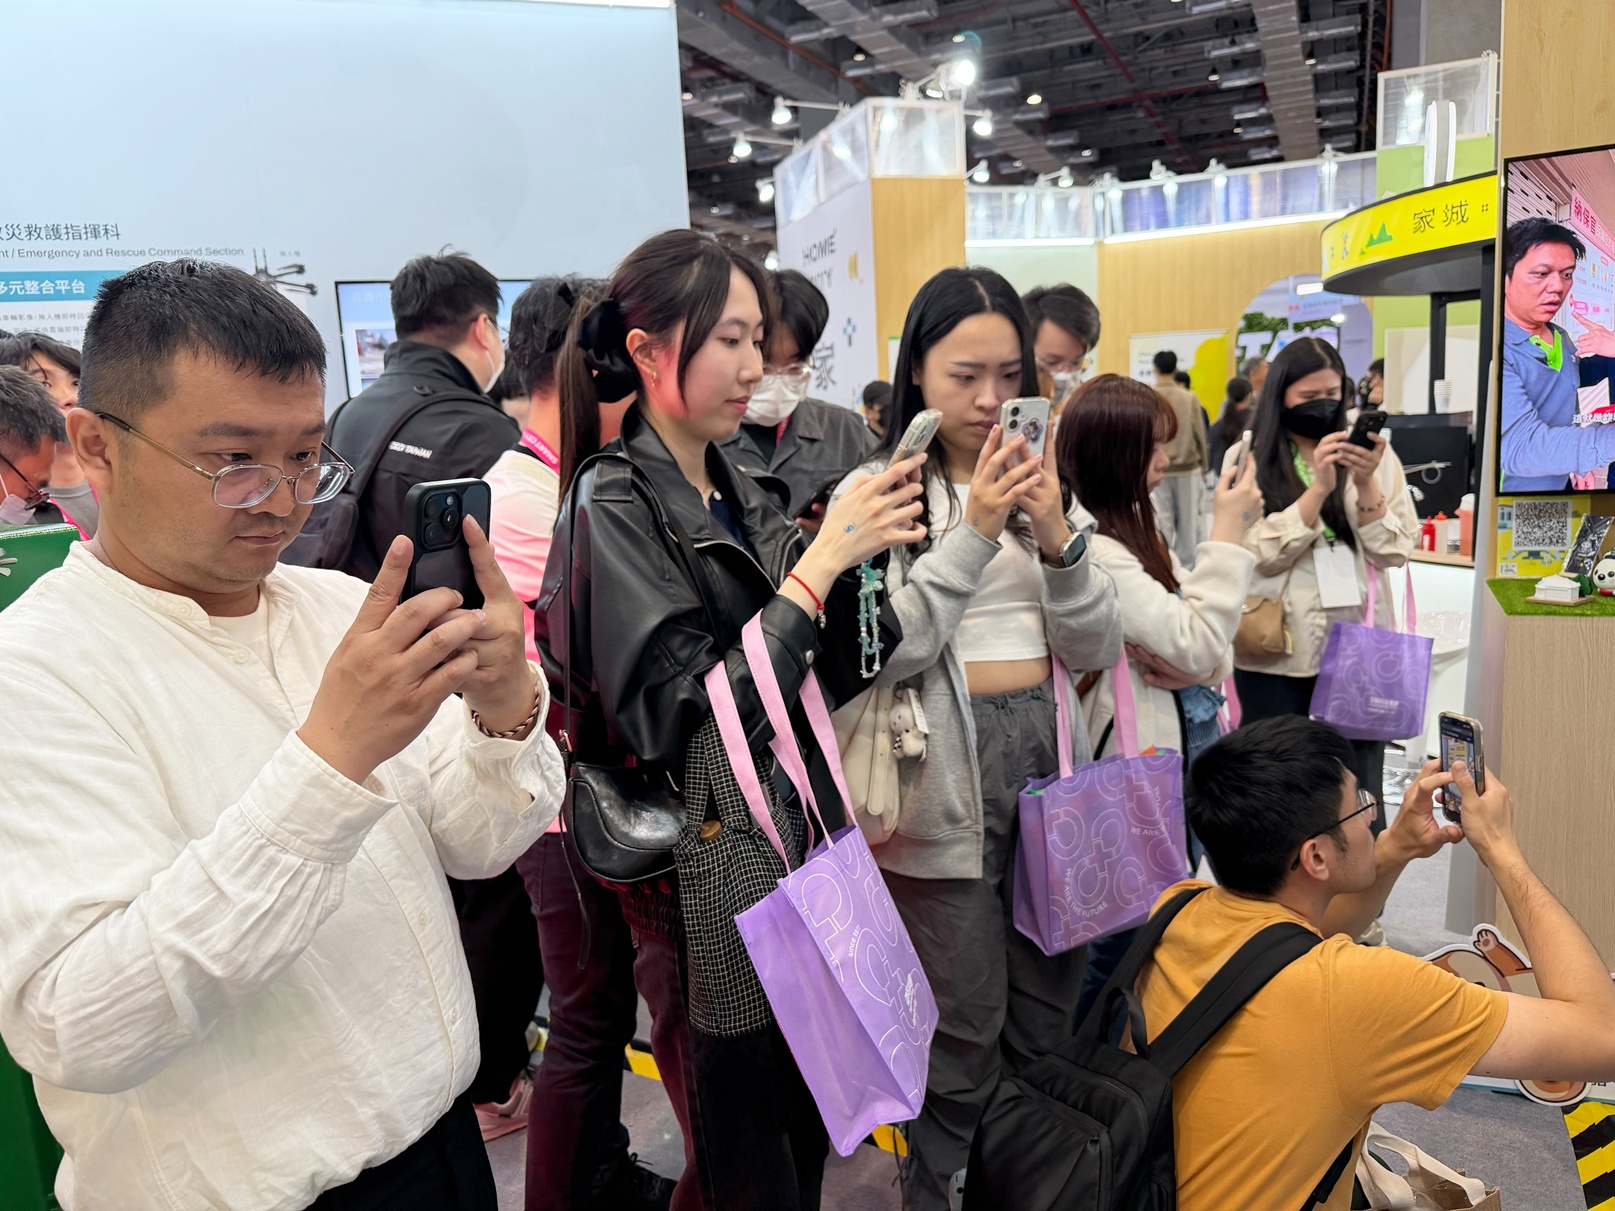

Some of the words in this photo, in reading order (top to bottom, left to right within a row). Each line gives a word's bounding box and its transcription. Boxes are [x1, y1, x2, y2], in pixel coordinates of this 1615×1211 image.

[17, 248, 81, 260] Emergency
[83, 248, 103, 258] and
[105, 247, 146, 257] Rescue
[148, 246, 202, 256] Command
[204, 246, 244, 256] Section
[405, 444, 432, 458] TAIWAN
[536, 441, 558, 464] SMART
[1130, 825, 1141, 836] WE
[1065, 868, 1072, 882] WE
[1064, 885, 1072, 903] ARE
[1082, 900, 1108, 917] FUTURE
